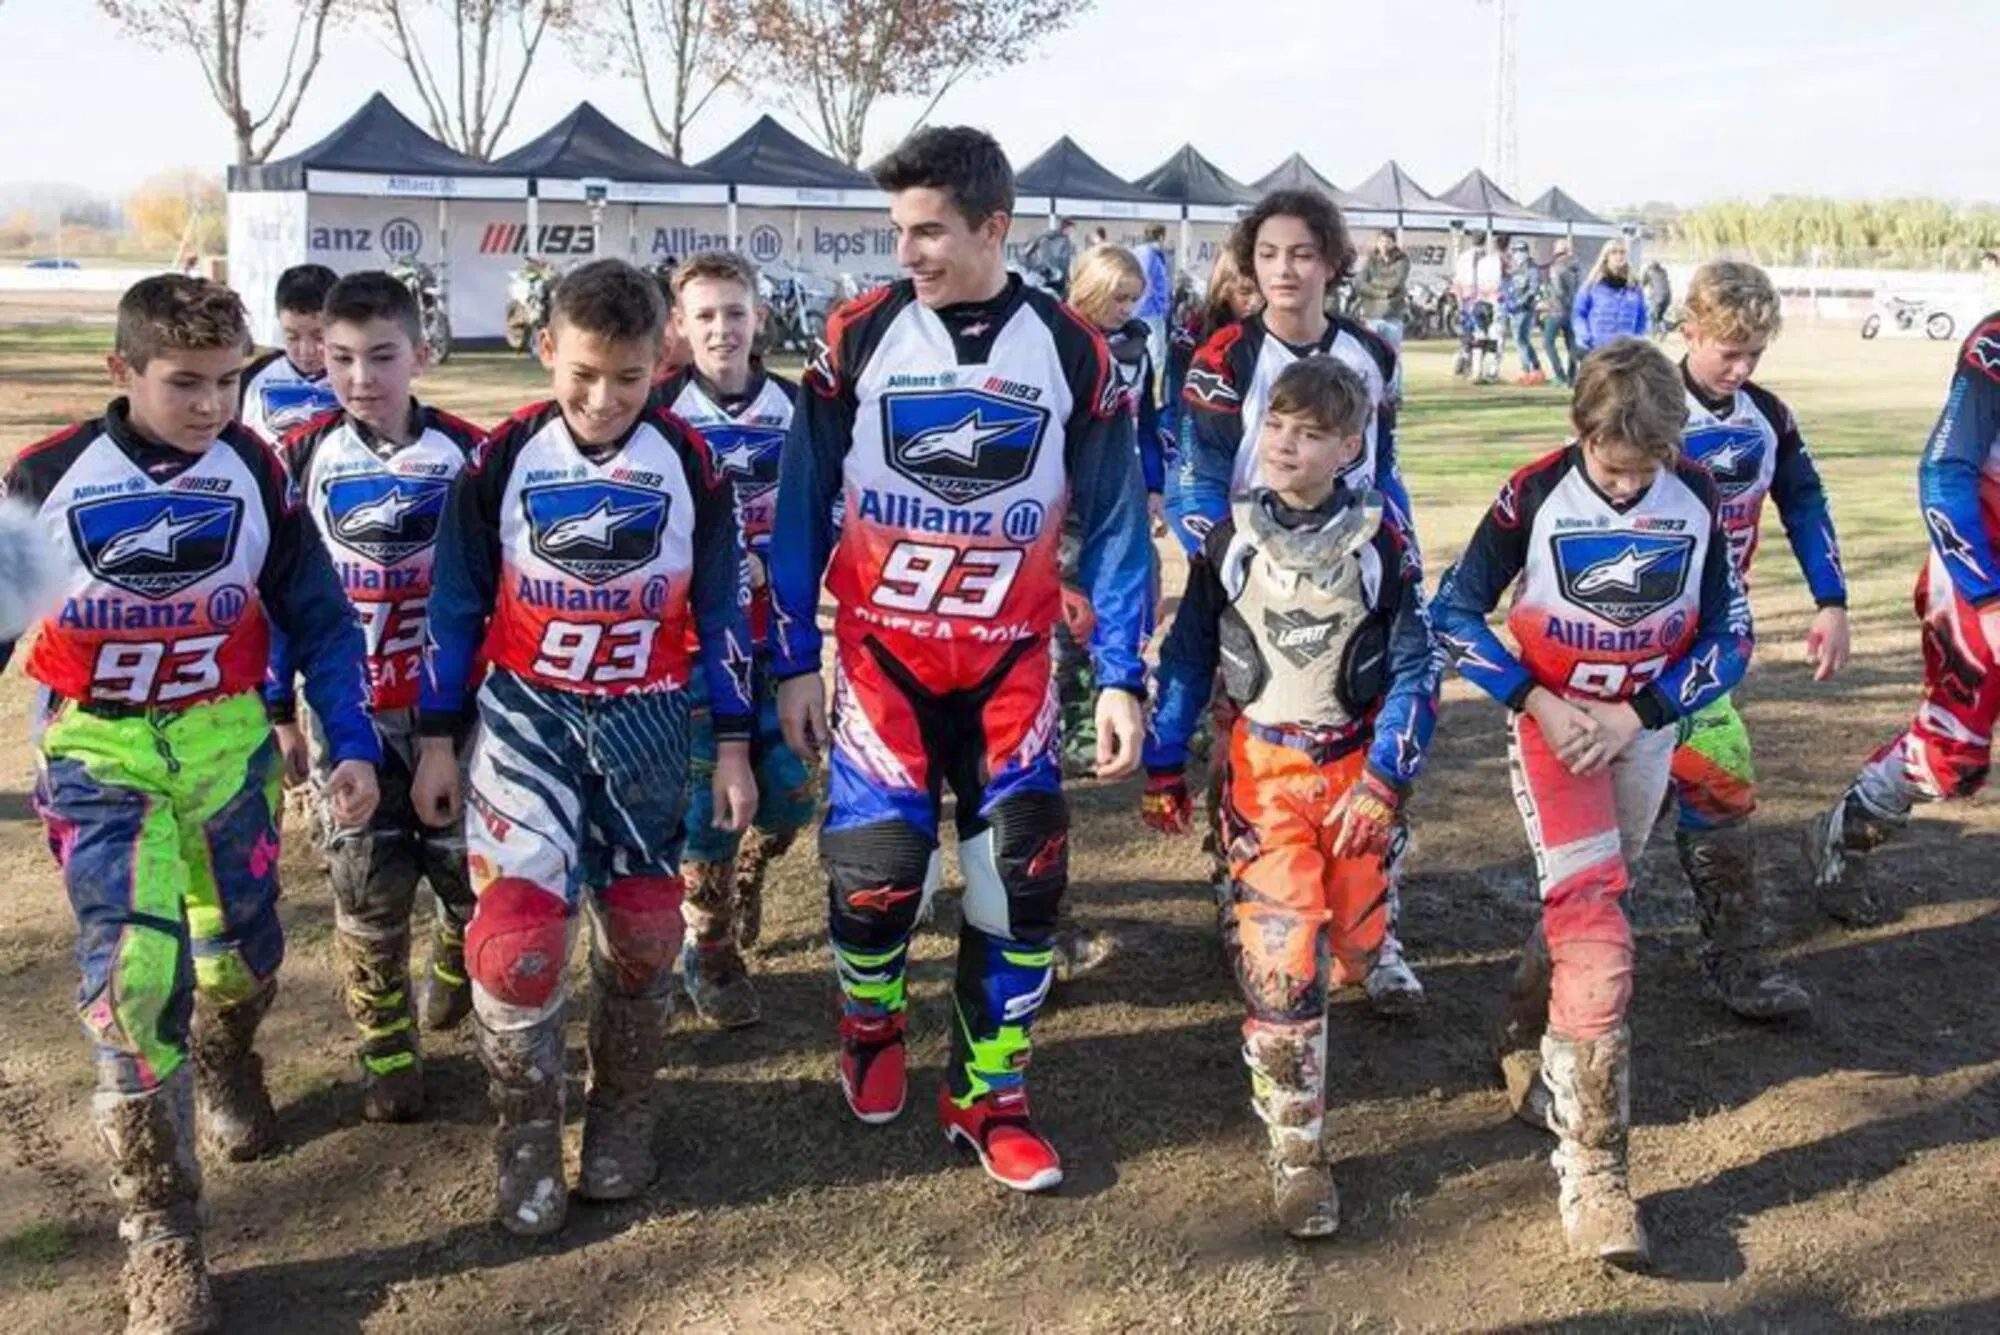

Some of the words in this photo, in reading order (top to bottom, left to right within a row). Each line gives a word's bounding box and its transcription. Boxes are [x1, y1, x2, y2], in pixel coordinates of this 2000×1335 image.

[651, 227, 743, 254] Allian
[814, 226, 866, 264] laps
[873, 228, 897, 255] lif
[858, 489, 993, 538] Allianz
[333, 561, 421, 590] lianz
[517, 574, 632, 613] Allianz
[871, 540, 1025, 619] 93
[59, 598, 196, 630] Allianz
[1543, 613, 1654, 652] Allianz
[91, 634, 230, 703] 93
[532, 617, 661, 682] 93
